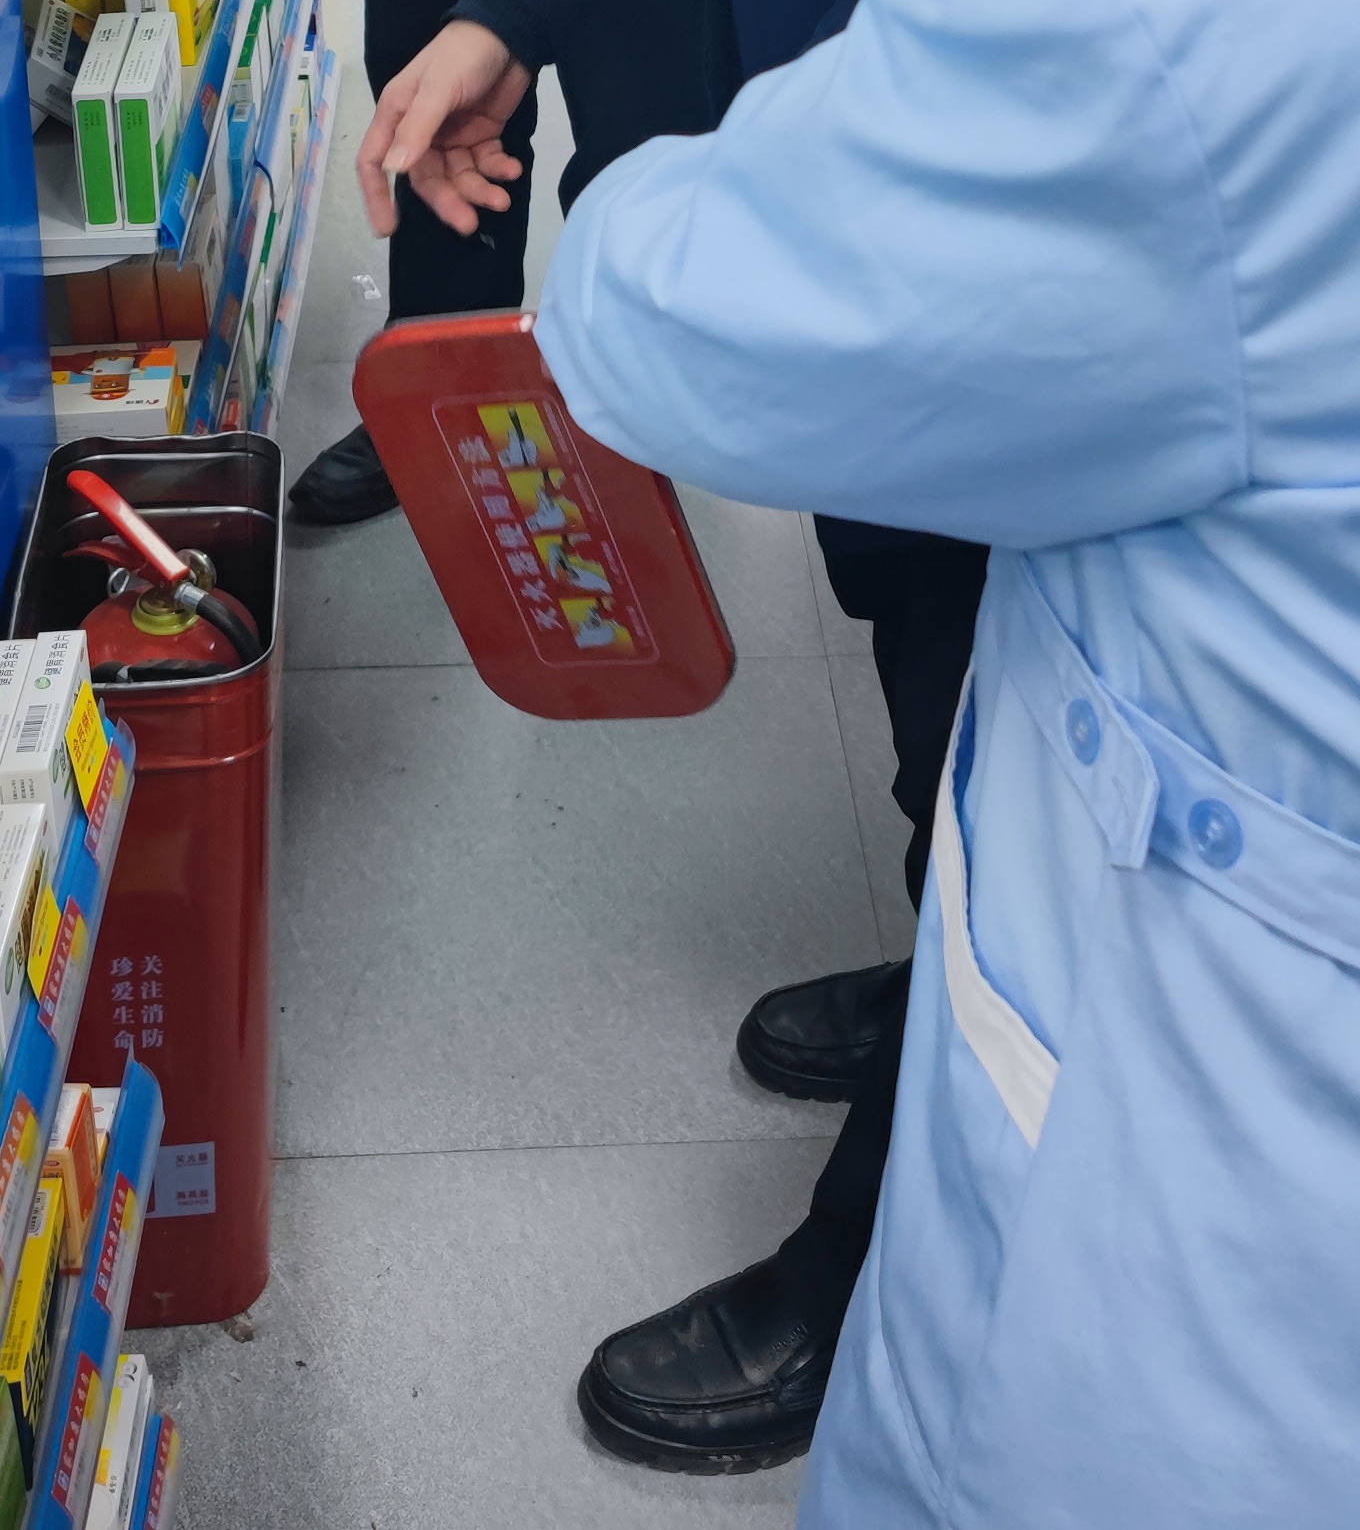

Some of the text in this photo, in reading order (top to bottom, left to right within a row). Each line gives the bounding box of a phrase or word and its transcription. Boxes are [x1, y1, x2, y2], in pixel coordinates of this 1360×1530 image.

[110, 956, 135, 1050] 珍爱生命
[140, 954, 164, 1049] 关注消防
